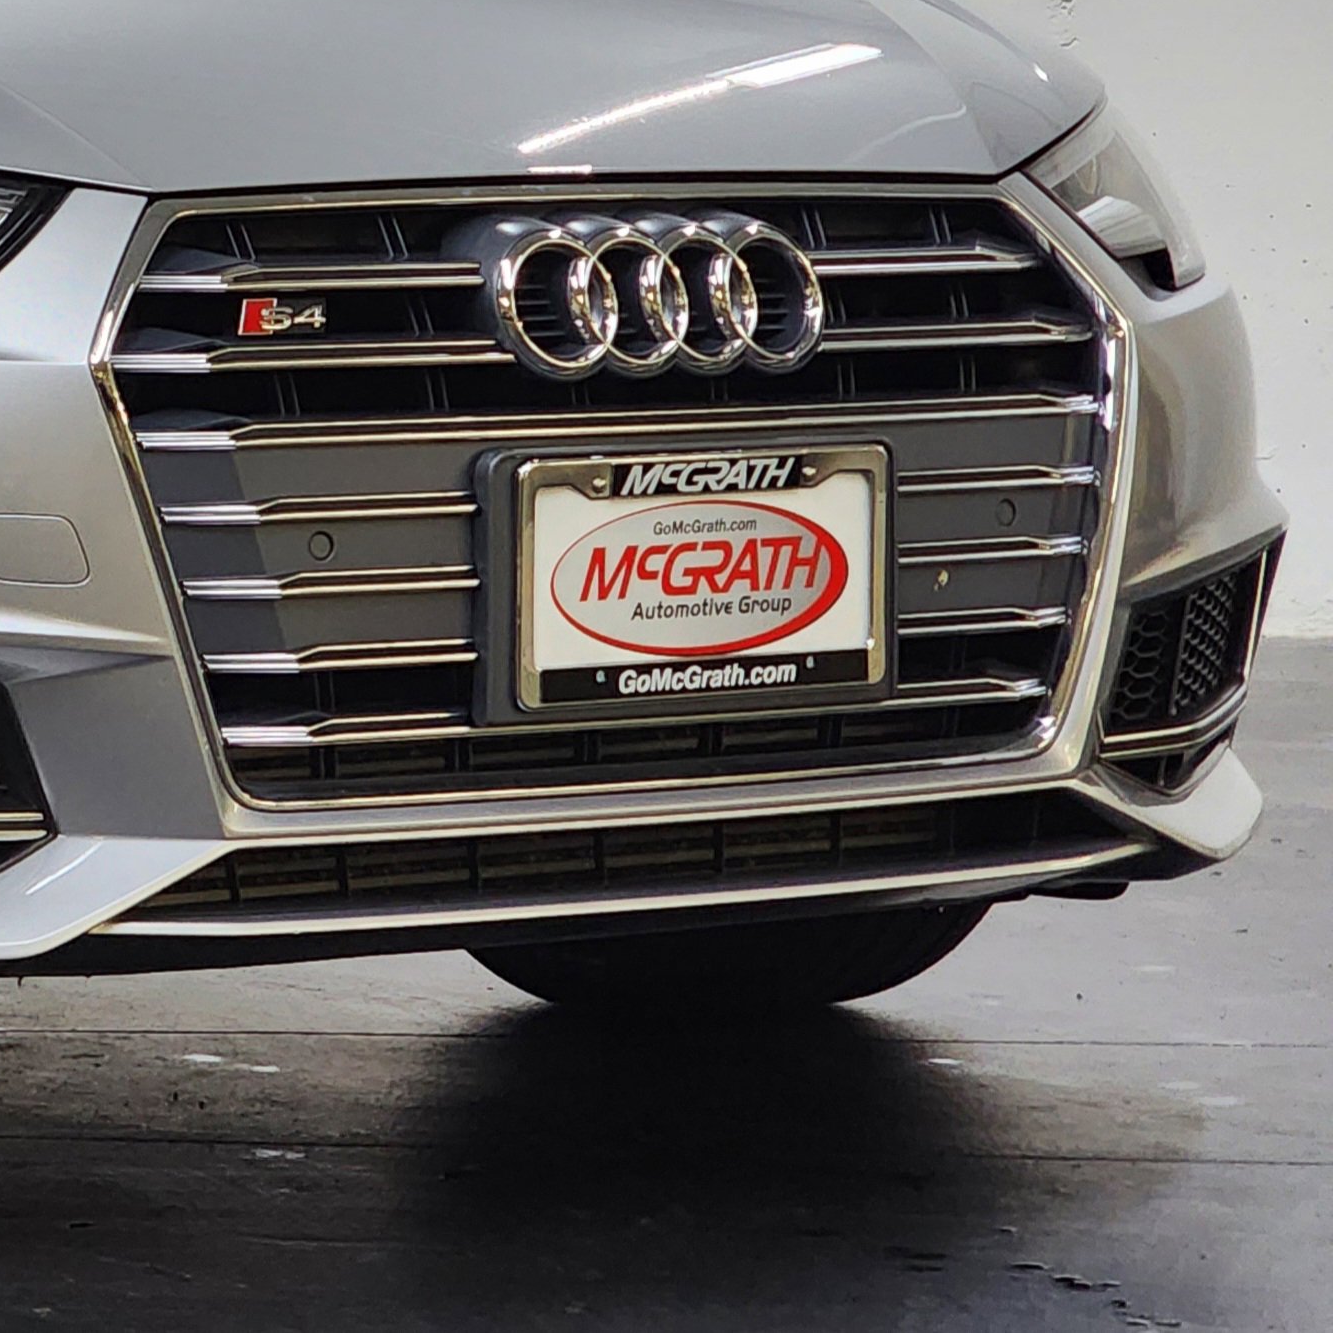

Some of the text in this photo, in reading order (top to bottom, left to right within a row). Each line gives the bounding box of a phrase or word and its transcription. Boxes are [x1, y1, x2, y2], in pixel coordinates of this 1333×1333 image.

[259, 305, 326, 330] S4
[653, 517, 757, 536] GoMcGrath.com
[631, 595, 792, 621] Automotive Group
[619, 663, 796, 695] GoMcGrath.com
